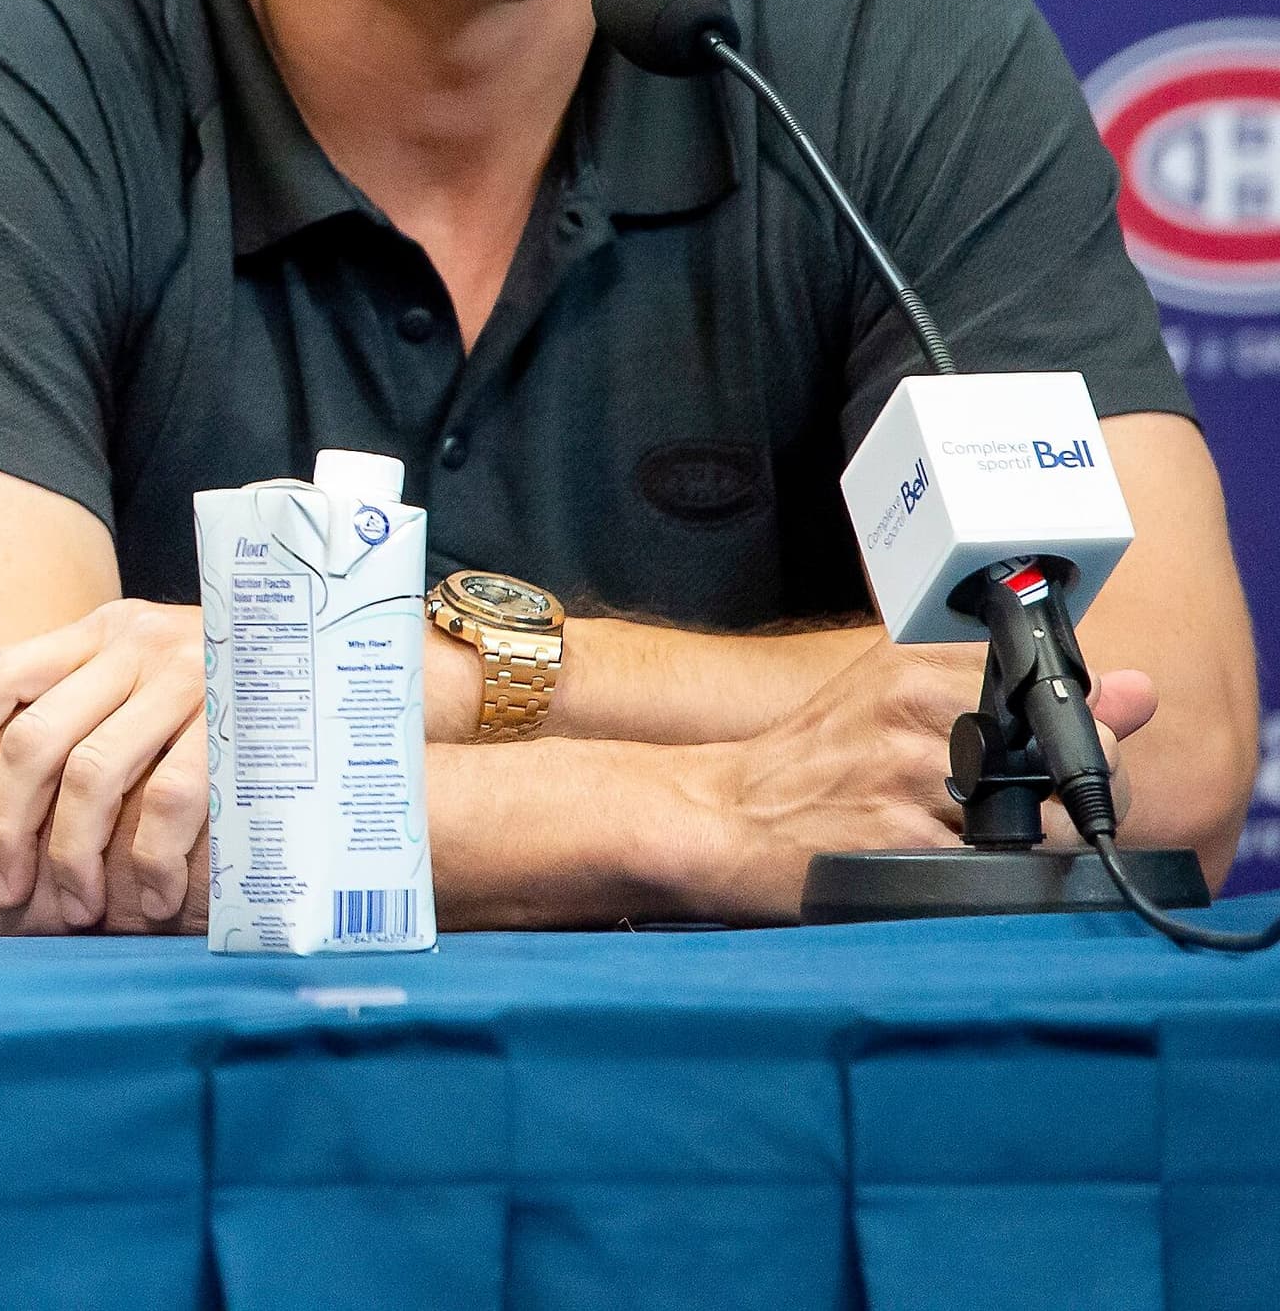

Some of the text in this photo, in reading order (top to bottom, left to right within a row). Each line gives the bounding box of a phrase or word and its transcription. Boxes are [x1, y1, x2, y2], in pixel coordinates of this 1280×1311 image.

[941, 440, 1028, 457] Complexe
[1032, 440, 1095, 469] Bell
[977, 455, 1033, 472] sportif
[901, 458, 929, 514] Bell
